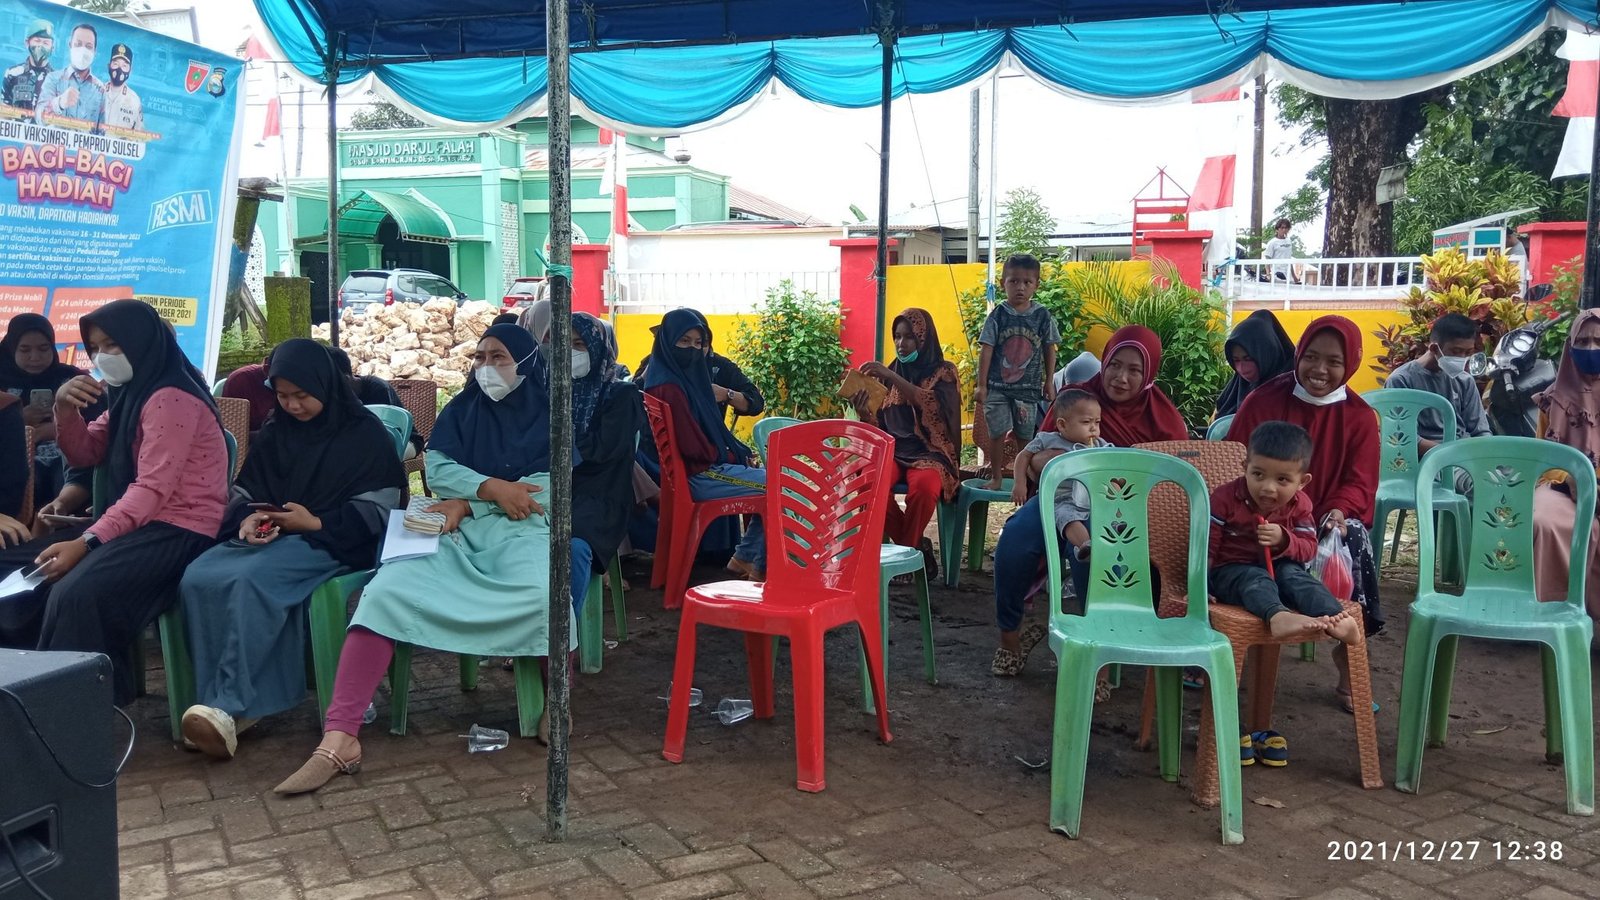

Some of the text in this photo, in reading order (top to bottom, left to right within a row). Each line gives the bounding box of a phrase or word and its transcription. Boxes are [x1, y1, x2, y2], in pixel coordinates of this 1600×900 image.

[24, 125, 71, 148] VAKSINASI,
[73, 134, 112, 153] PEMPROV
[112, 140, 140, 158] SULSEL
[348, 143, 391, 158] MASJID
[394, 141, 434, 156] DARUL
[2, 145, 134, 187] BAGI-BAGI
[18, 172, 117, 207] HADIAH
[38, 207, 78, 222] DAPATKAN
[152, 193, 206, 229] RESMI
[15, 225, 50, 235] melakukan
[52, 228, 80, 237] vaksinasi
[10, 234, 49, 245] didapatkan
[7, 244, 38, 252] vaksinasi
[8, 252, 41, 261] sertifikat
[42, 254, 72, 263] vaksinasi
[160, 297, 187, 309] PERIODE
[176, 309, 192, 319] 2021
